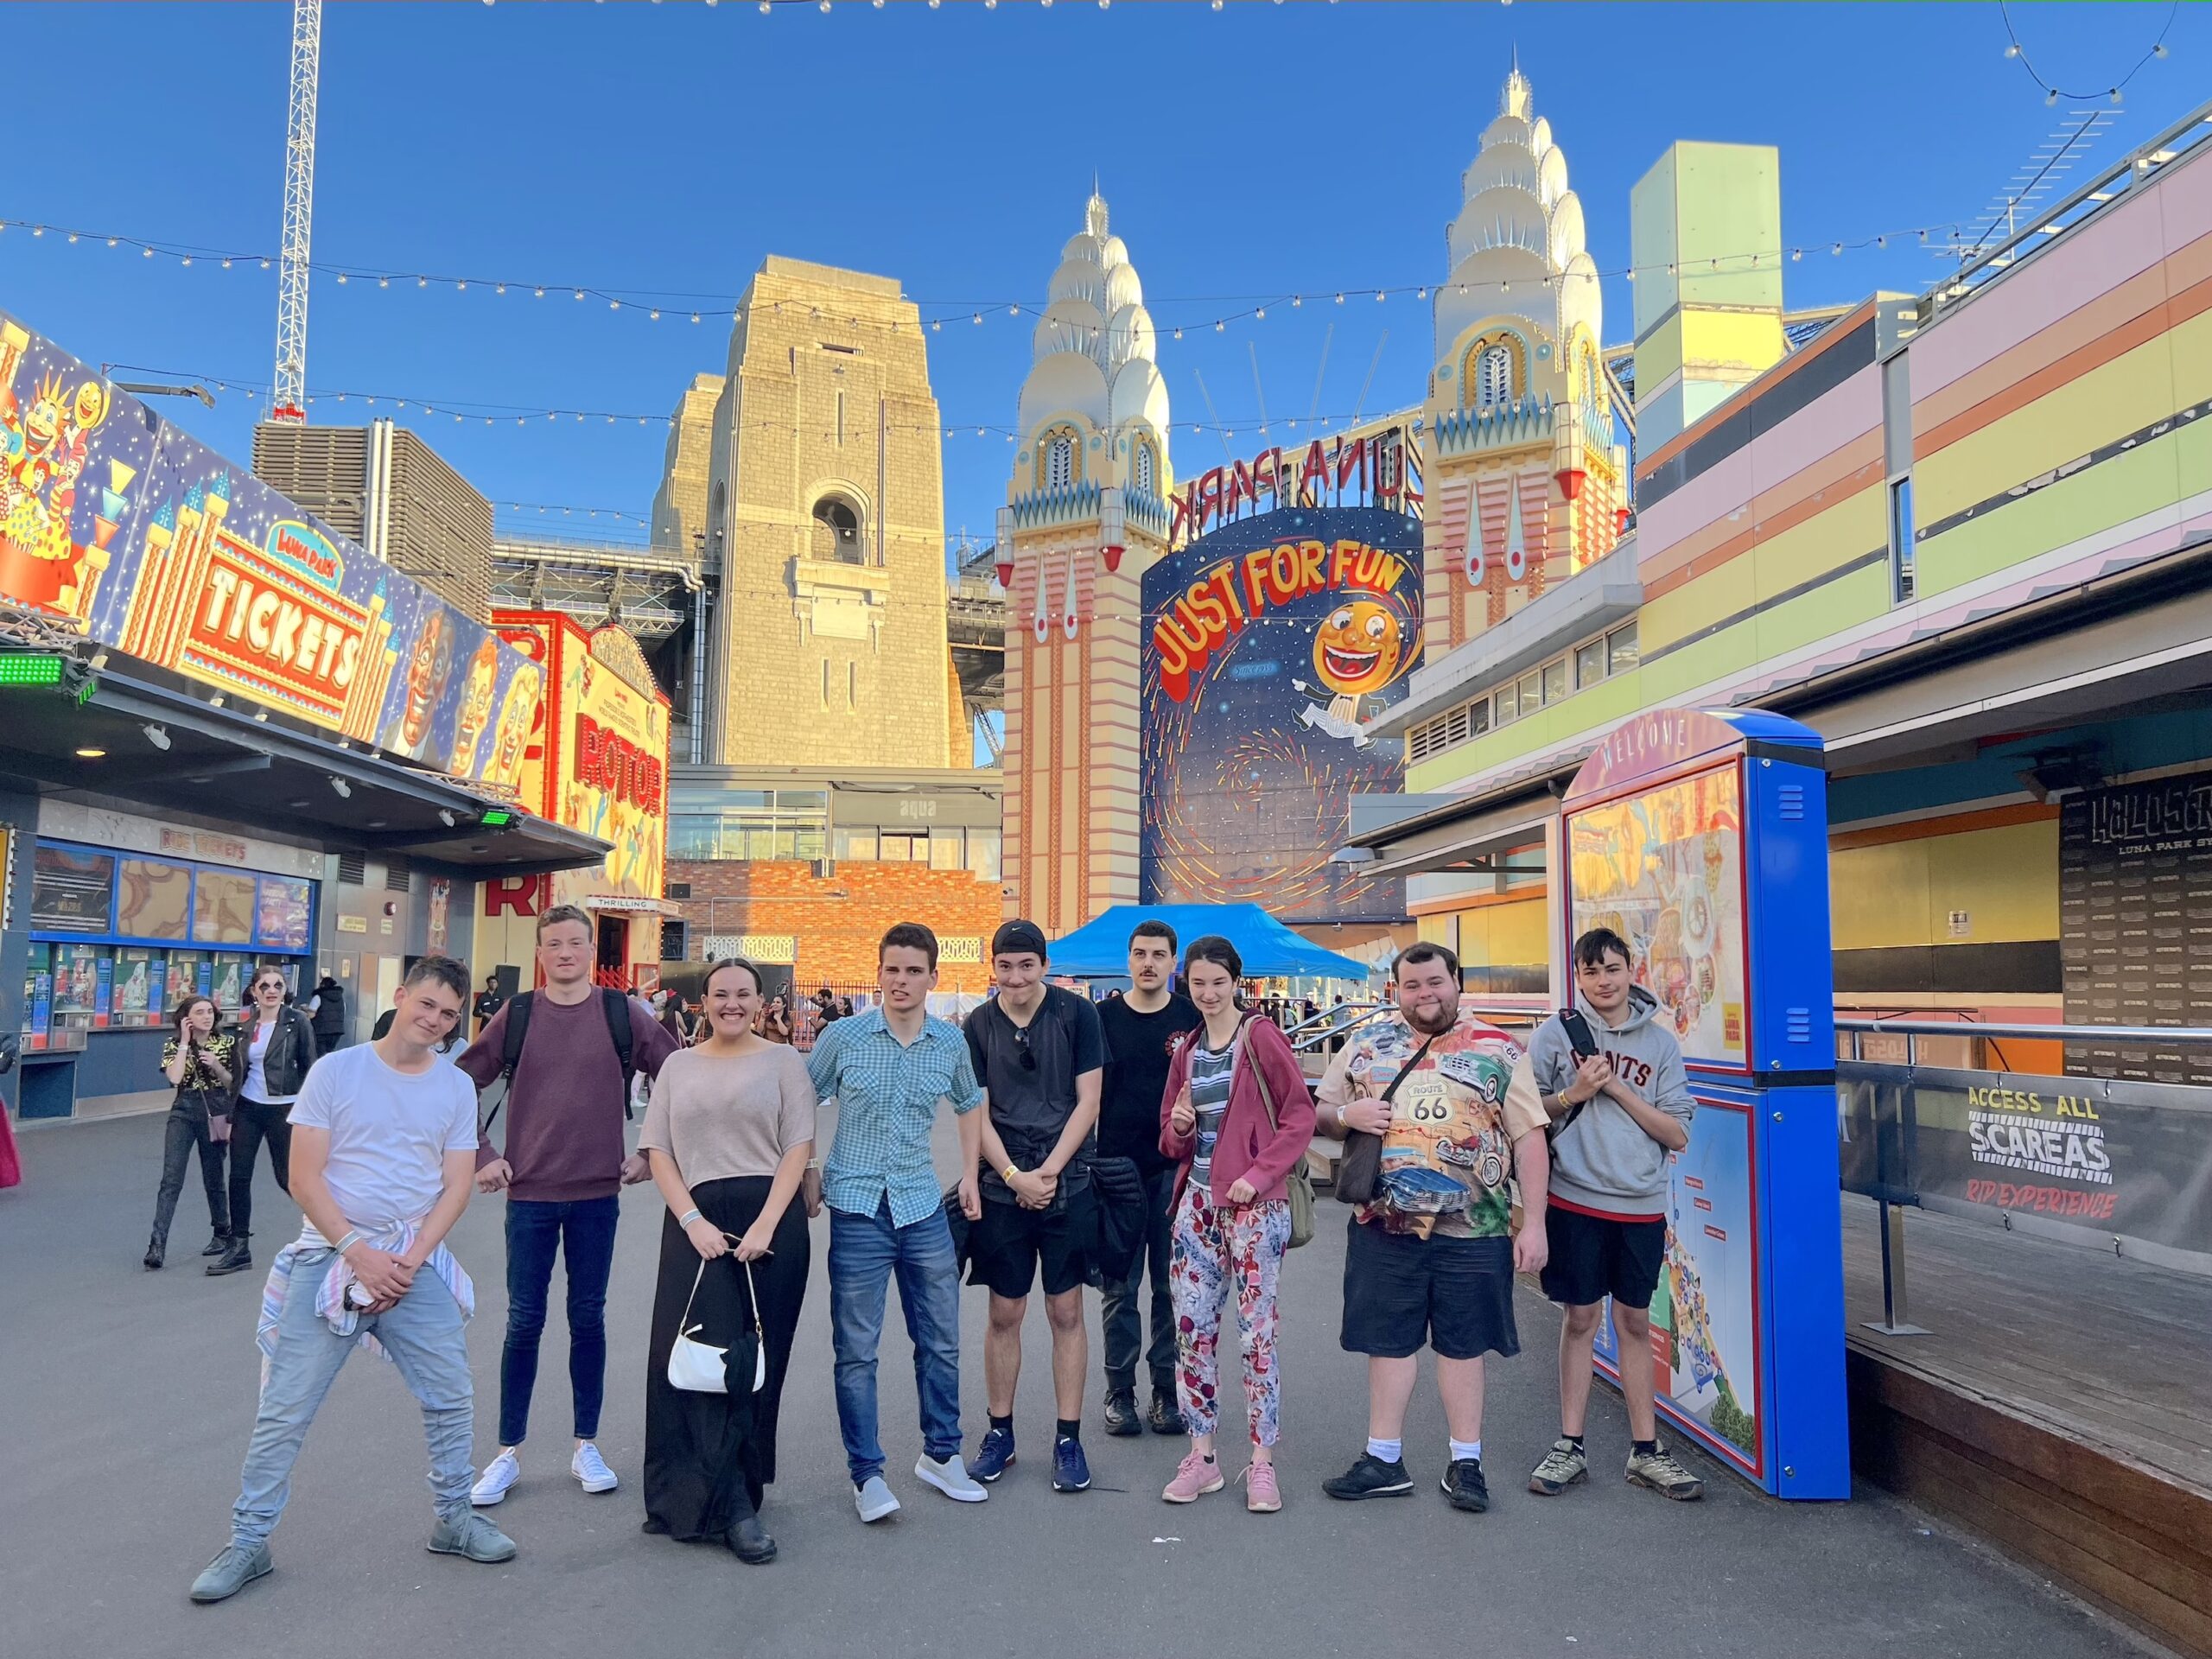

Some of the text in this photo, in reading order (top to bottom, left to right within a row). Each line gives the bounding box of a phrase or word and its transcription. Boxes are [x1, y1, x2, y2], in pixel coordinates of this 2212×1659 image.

[276, 527, 337, 580] LUNA PARK
[1153, 539, 1406, 678] JUST FOR FUN
[202, 565, 361, 690] TICKETS
[1603, 719, 1686, 772] WELCOME
[574, 713, 662, 818] ROTOR
[899, 800, 937, 820] aqua
[2119, 844, 2152, 855] LUNA
[2156, 840, 2192, 851] PARK
[598, 899, 647, 908] THRILLING
[1506, 1047, 1517, 1060] 66
[1414, 1084, 1443, 1095] ROUTE
[1968, 1086, 2100, 1120] ACCESS ALL
[1414, 1097, 1447, 1121] 66
[1968, 1122, 2111, 1171] SCAREAS
[1966, 1179, 2120, 1219] RIP EXPERIENCE
